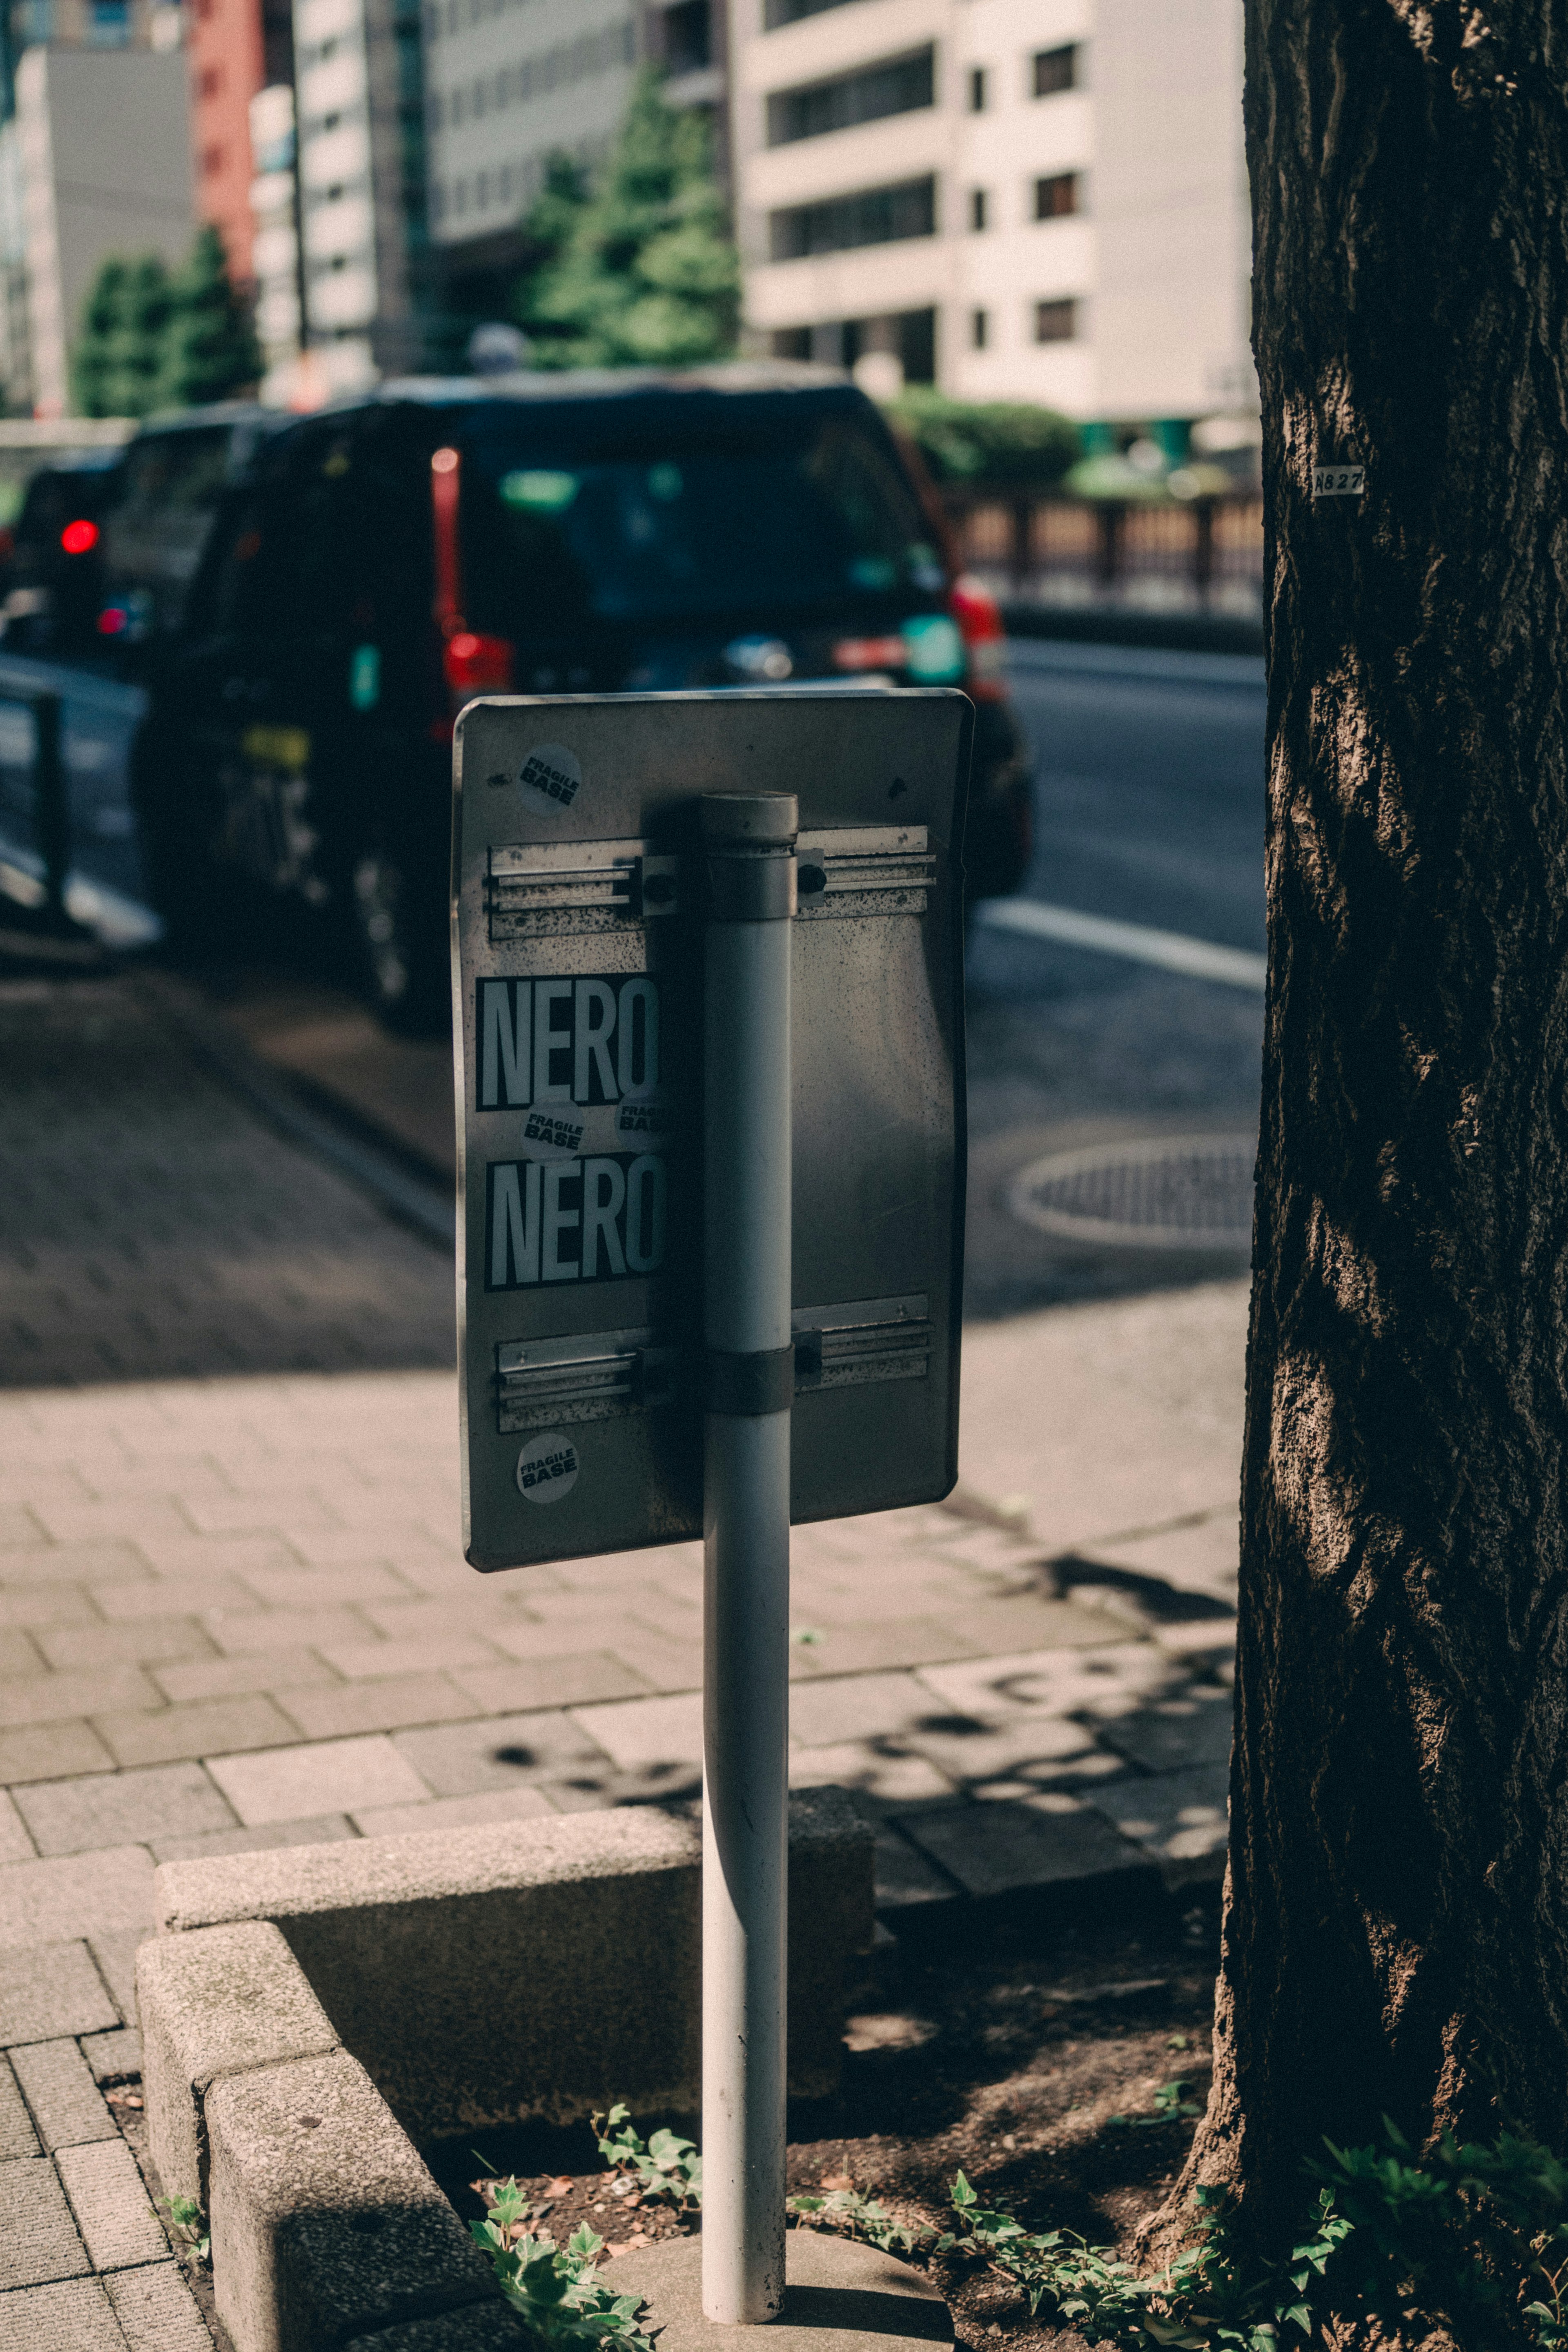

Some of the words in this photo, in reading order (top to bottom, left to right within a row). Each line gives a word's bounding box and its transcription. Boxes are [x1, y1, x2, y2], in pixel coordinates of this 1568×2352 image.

[520, 766, 575, 806] BASE
[528, 757, 579, 791] FRAGILE
[482, 978, 659, 1106] NERO
[524, 1124, 580, 1150] BASE
[529, 1114, 583, 1135] FRAGILE
[492, 1154, 667, 1286] NERO
[521, 1448, 574, 1474] FRAGILE
[522, 1458, 577, 1489] BASE
